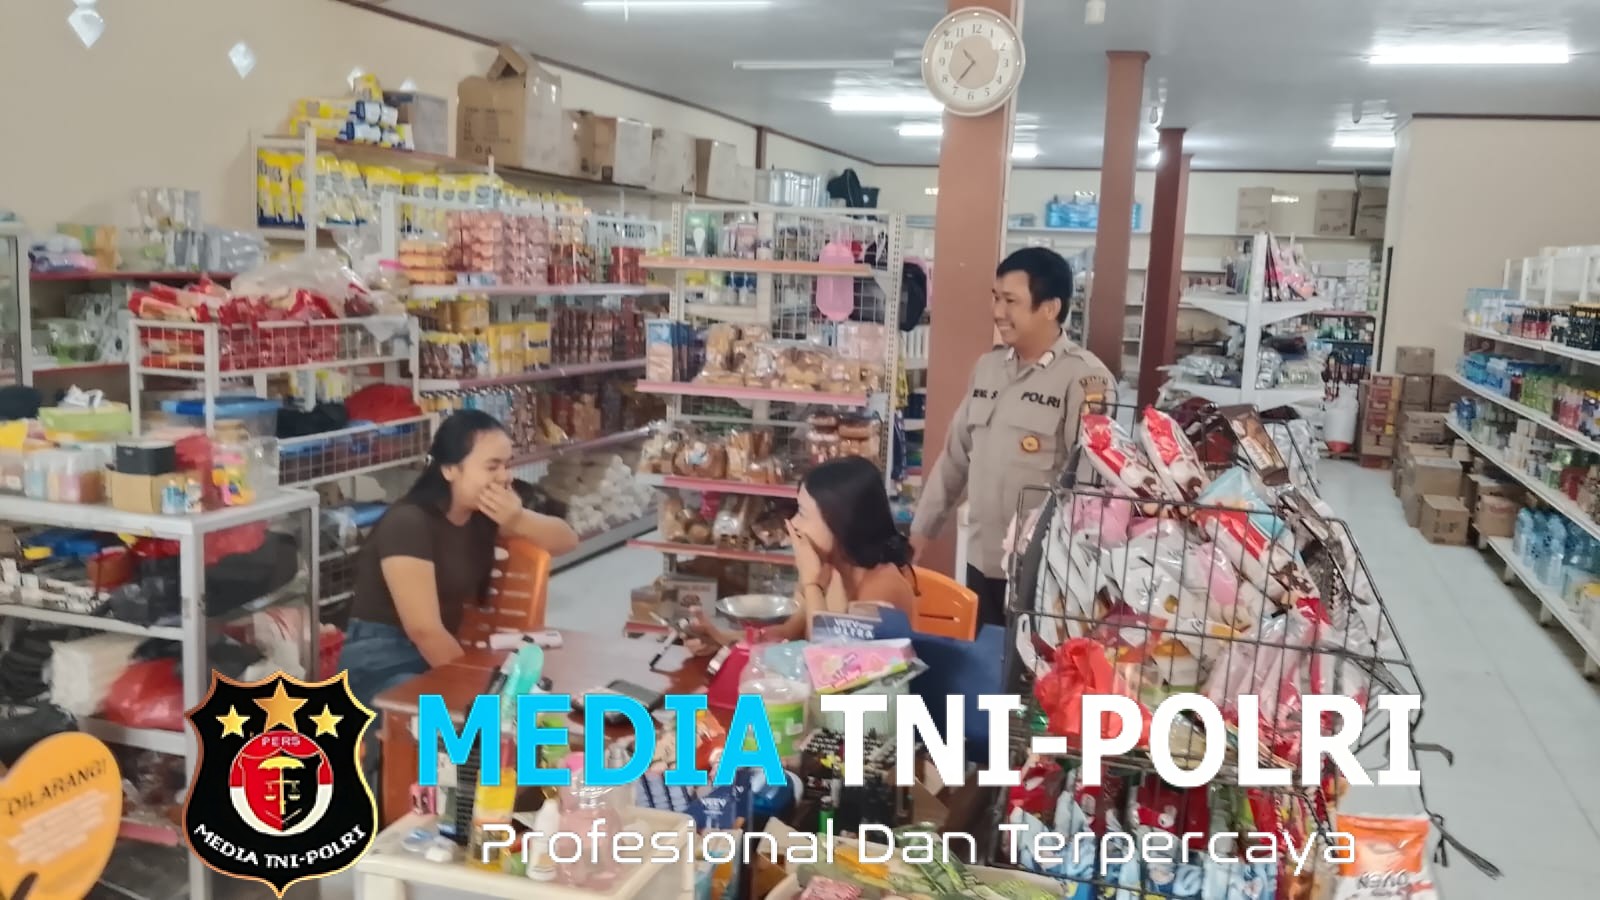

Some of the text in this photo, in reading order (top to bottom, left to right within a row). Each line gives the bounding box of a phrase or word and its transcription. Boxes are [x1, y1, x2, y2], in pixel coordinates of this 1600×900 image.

[956, 28, 965, 37] 11
[972, 24, 983, 33] 12
[944, 40, 953, 49] 10
[1021, 391, 1061, 408] POLRI
[8, 758, 107, 816] DILARANG!
